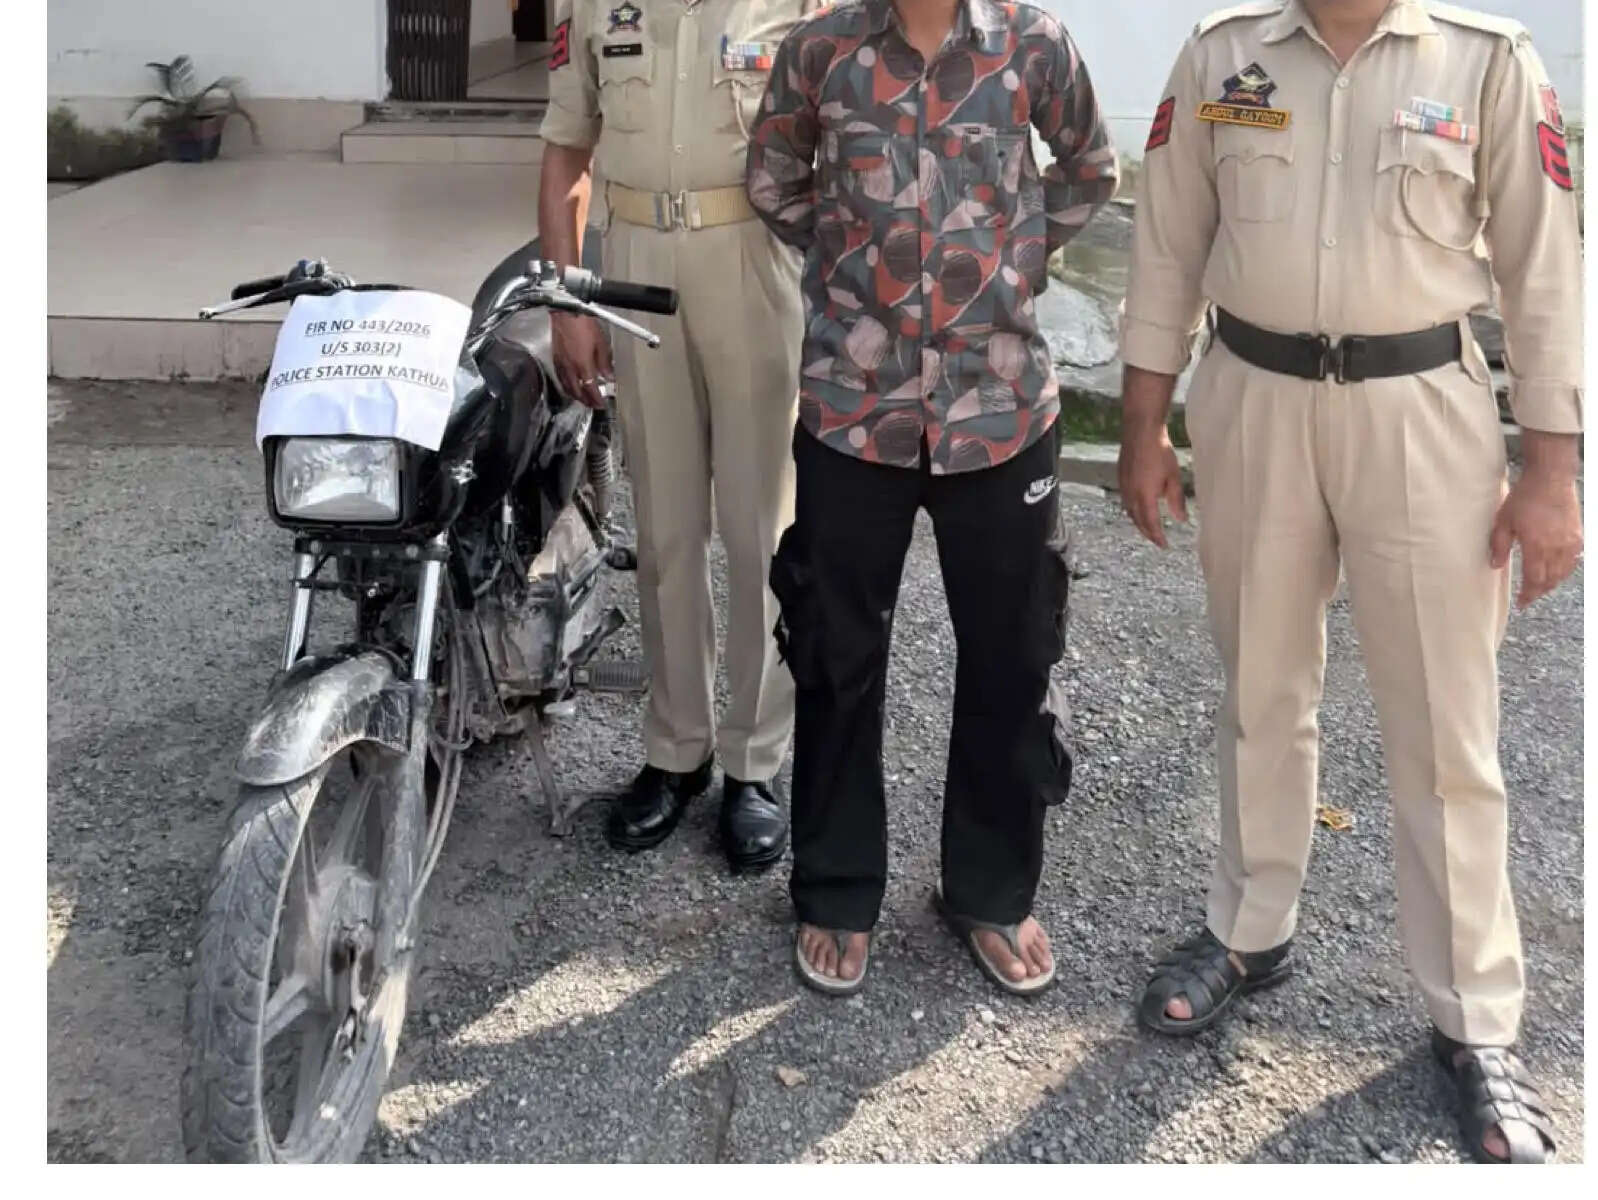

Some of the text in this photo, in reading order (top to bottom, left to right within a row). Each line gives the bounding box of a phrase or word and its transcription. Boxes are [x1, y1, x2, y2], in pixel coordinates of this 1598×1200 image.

[305, 321, 326, 335] FIR
[330, 319, 354, 332] NO
[321, 341, 401, 357] U/S 303(2)
[315, 363, 383, 378] STATION
[387, 365, 450, 389] KATHUA
